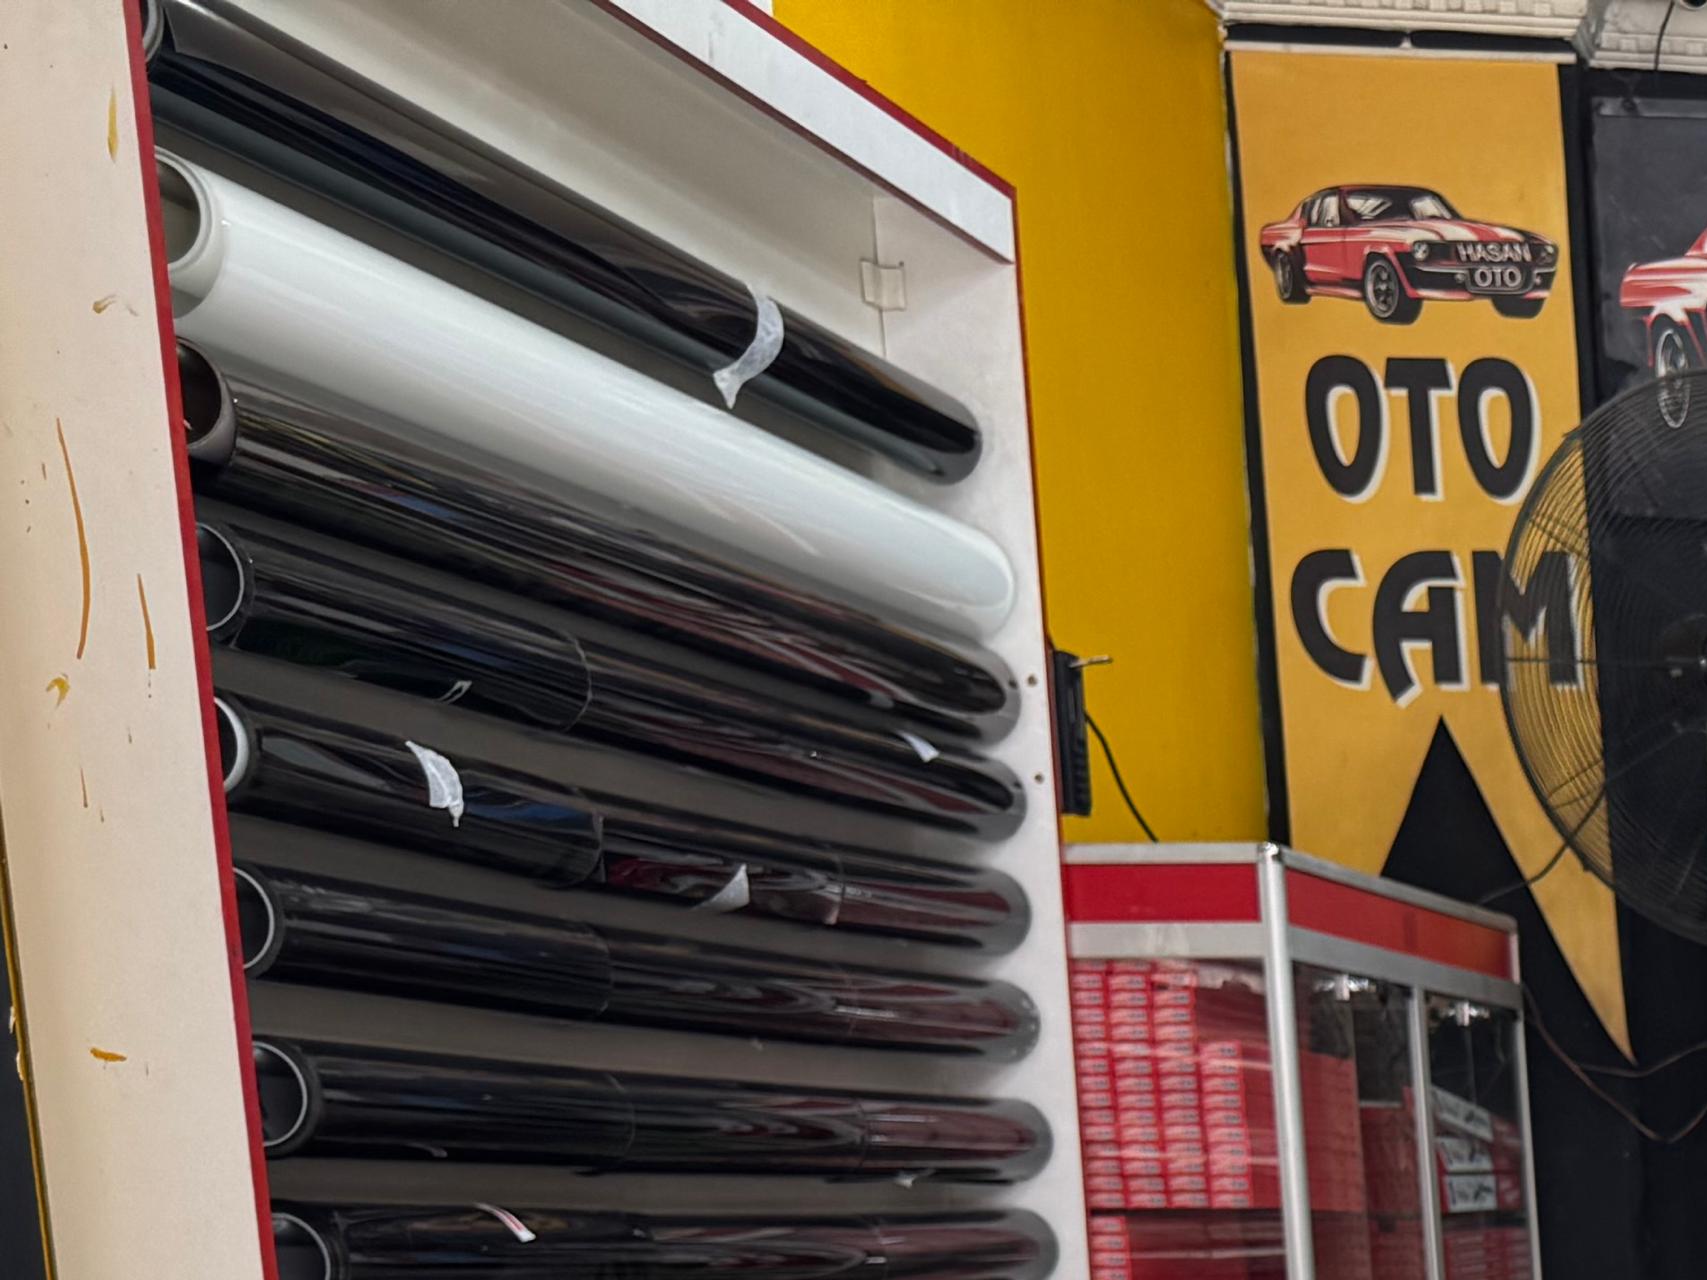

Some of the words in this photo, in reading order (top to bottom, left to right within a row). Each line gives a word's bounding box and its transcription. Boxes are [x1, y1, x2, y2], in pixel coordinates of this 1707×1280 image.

[1457, 242, 1532, 262] HASAN
[1475, 267, 1522, 287] OTO
[1305, 354, 1541, 504] OTO
[1290, 548, 1588, 709] CAM
